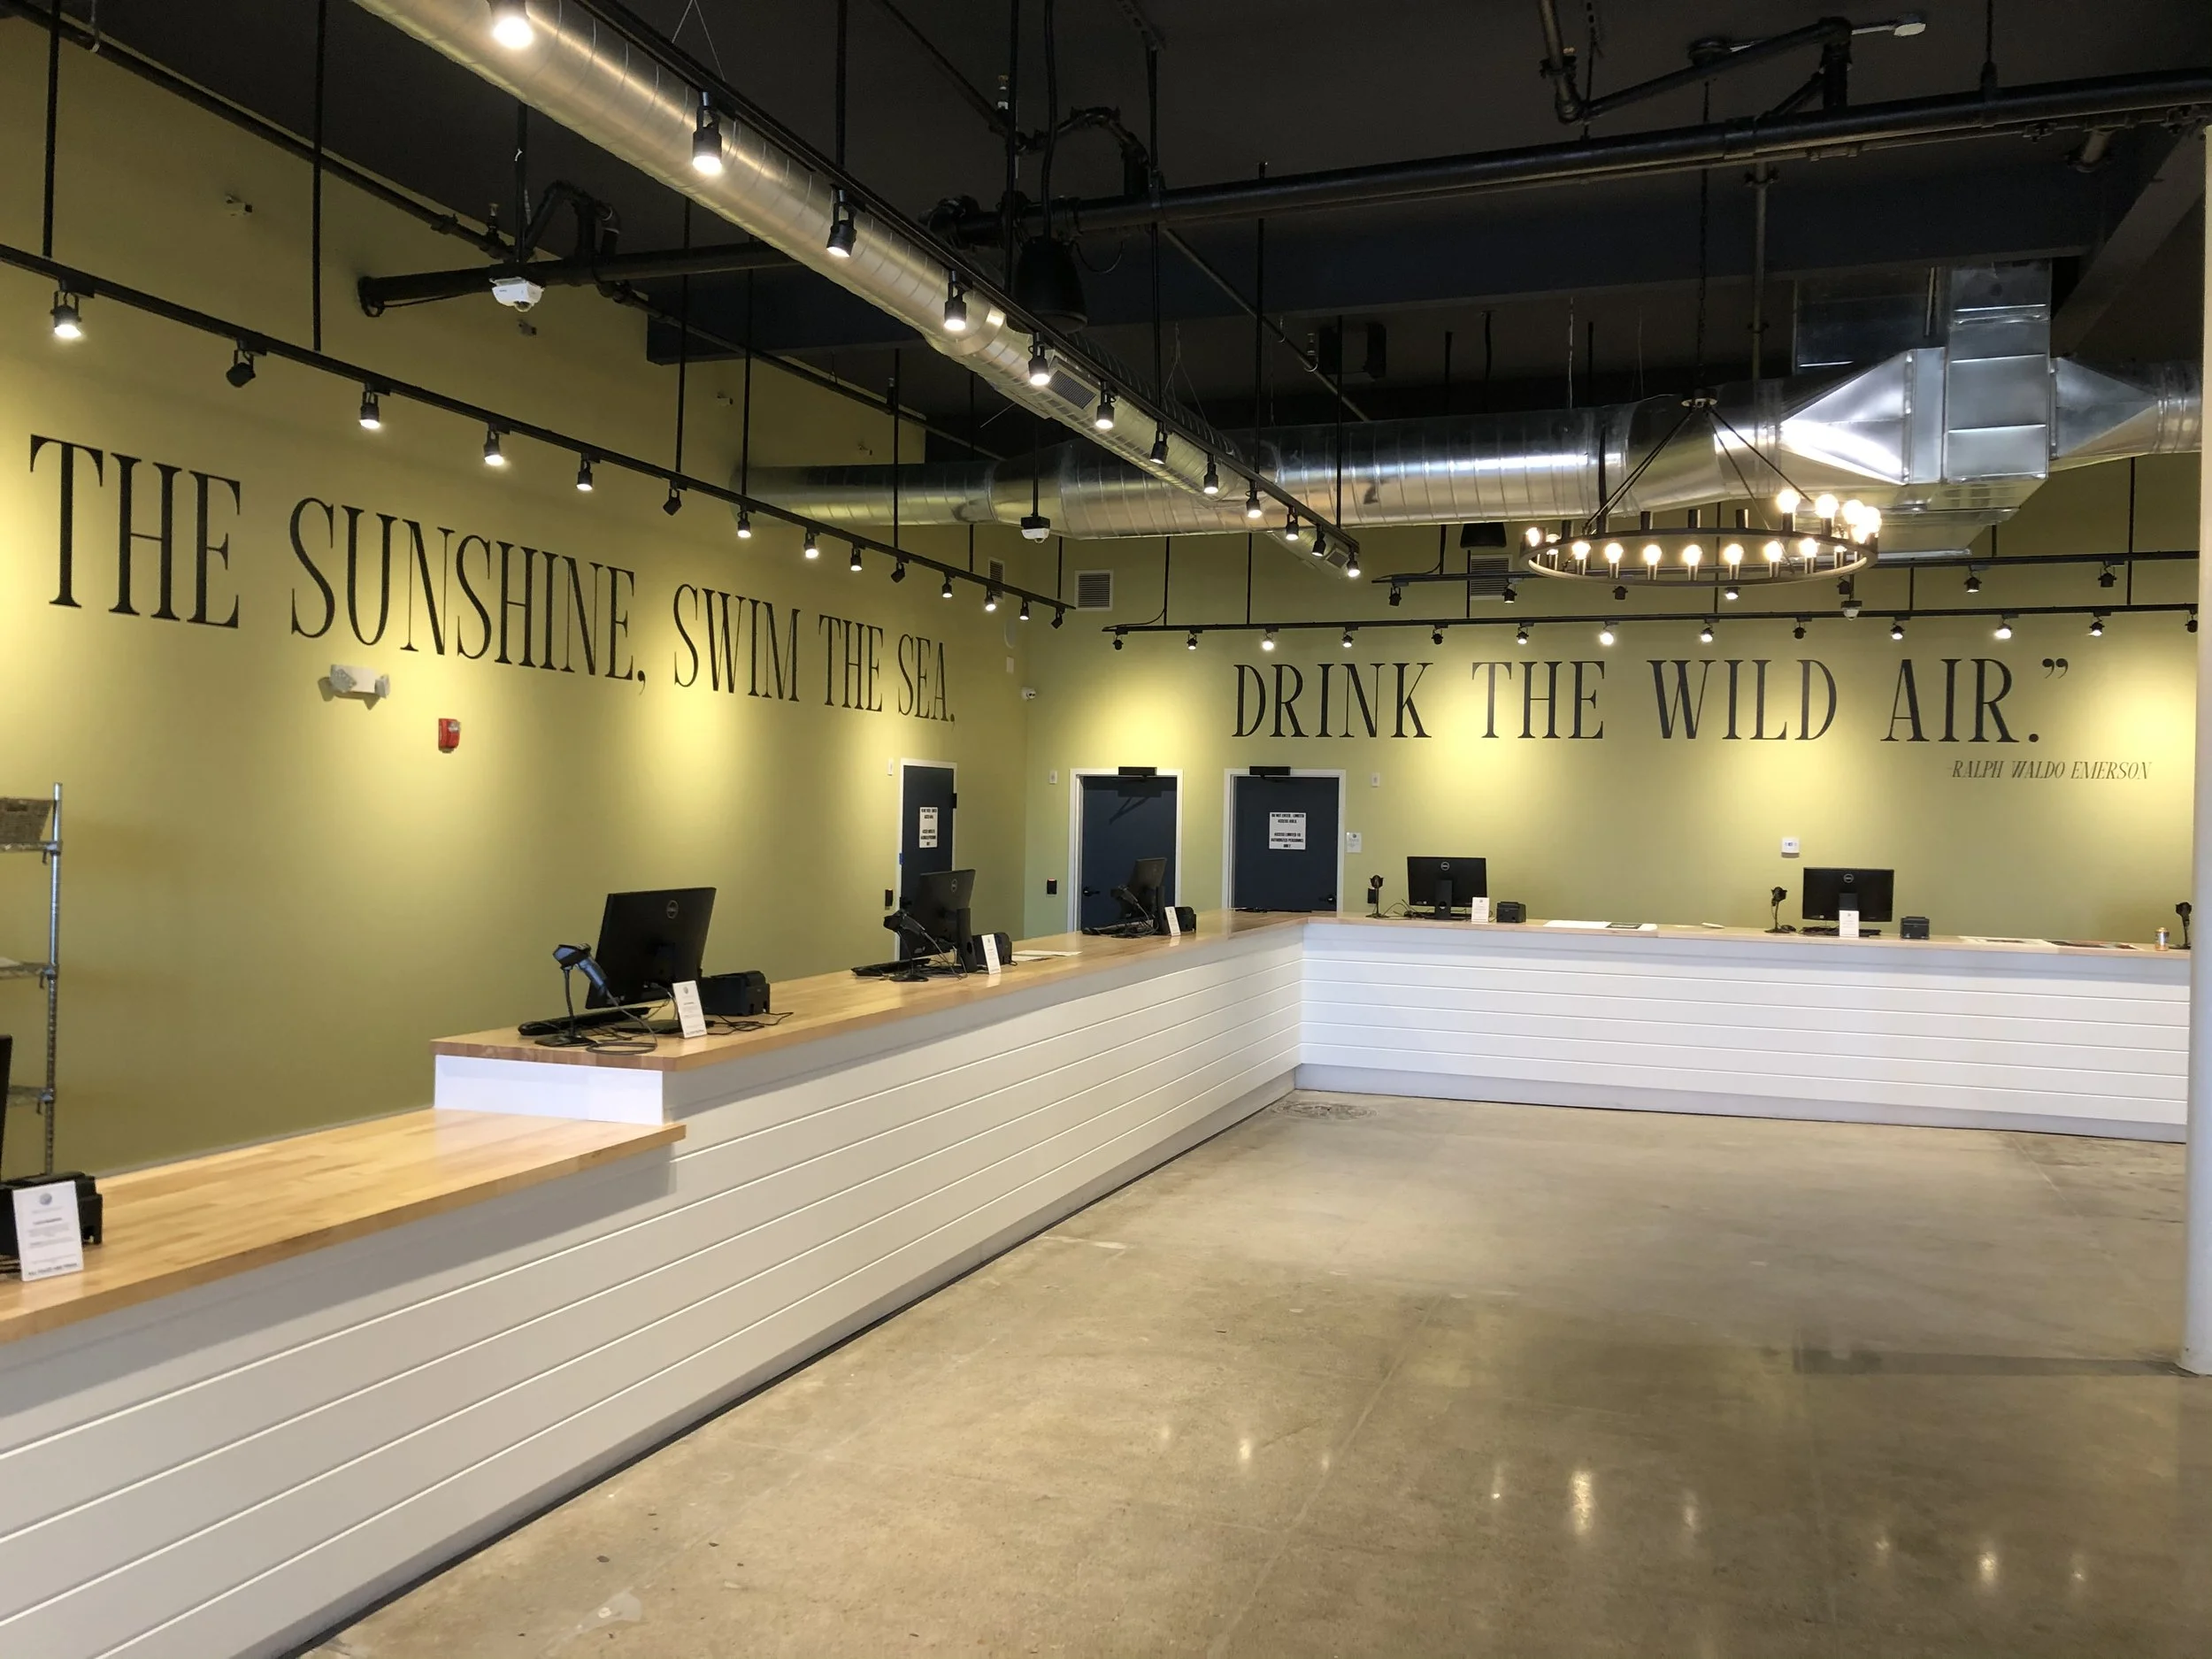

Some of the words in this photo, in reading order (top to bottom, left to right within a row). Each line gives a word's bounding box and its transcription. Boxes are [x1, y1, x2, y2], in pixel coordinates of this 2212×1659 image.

[30, 434, 241, 629] THE
[289, 496, 647, 695] SUNSHINE,
[673, 583, 802, 703] SWIM
[818, 614, 884, 712] THE
[1232, 662, 1434, 739] DRINK
[1471, 660, 1606, 740] THE
[1646, 659, 1838, 741] WILD
[2011, 760, 2066, 779] WALDO
[2070, 761, 2153, 780] EMERSON
